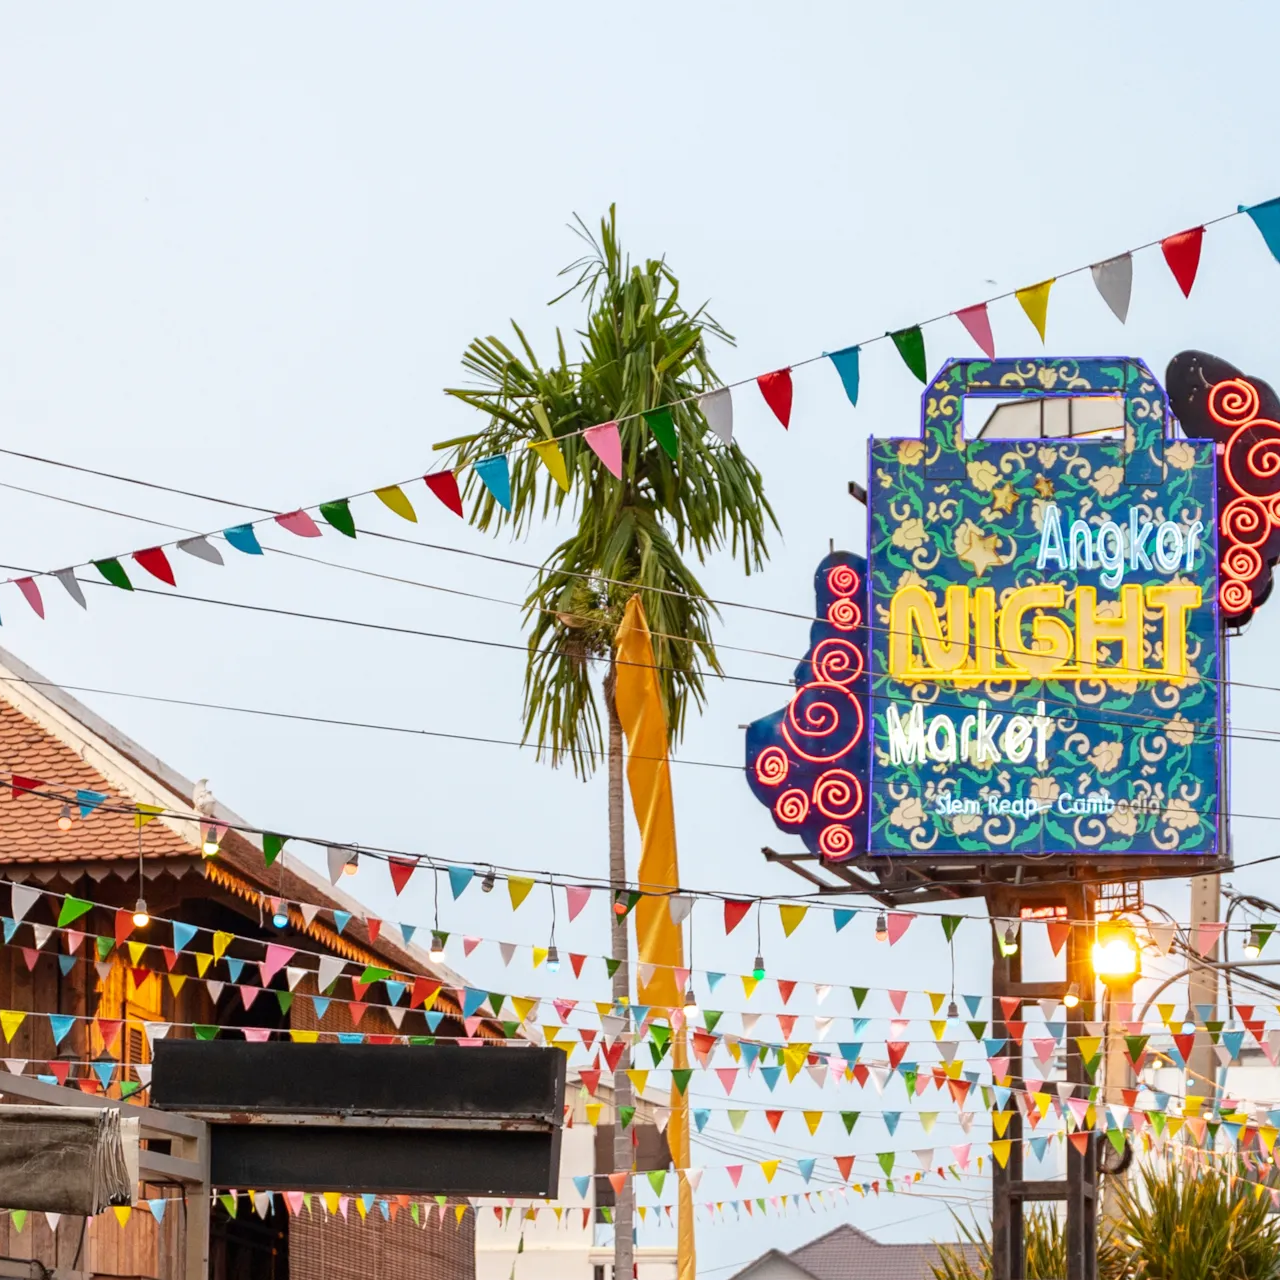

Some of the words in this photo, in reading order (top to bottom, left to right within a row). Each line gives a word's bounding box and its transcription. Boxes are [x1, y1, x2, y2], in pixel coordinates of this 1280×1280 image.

[1037, 505, 1203, 588] Angkor
[887, 584, 1202, 682] NIGHT
[886, 700, 1050, 766] Market
[988, 794, 1038, 820] Reap
[1058, 791, 1161, 816] Cambodia
